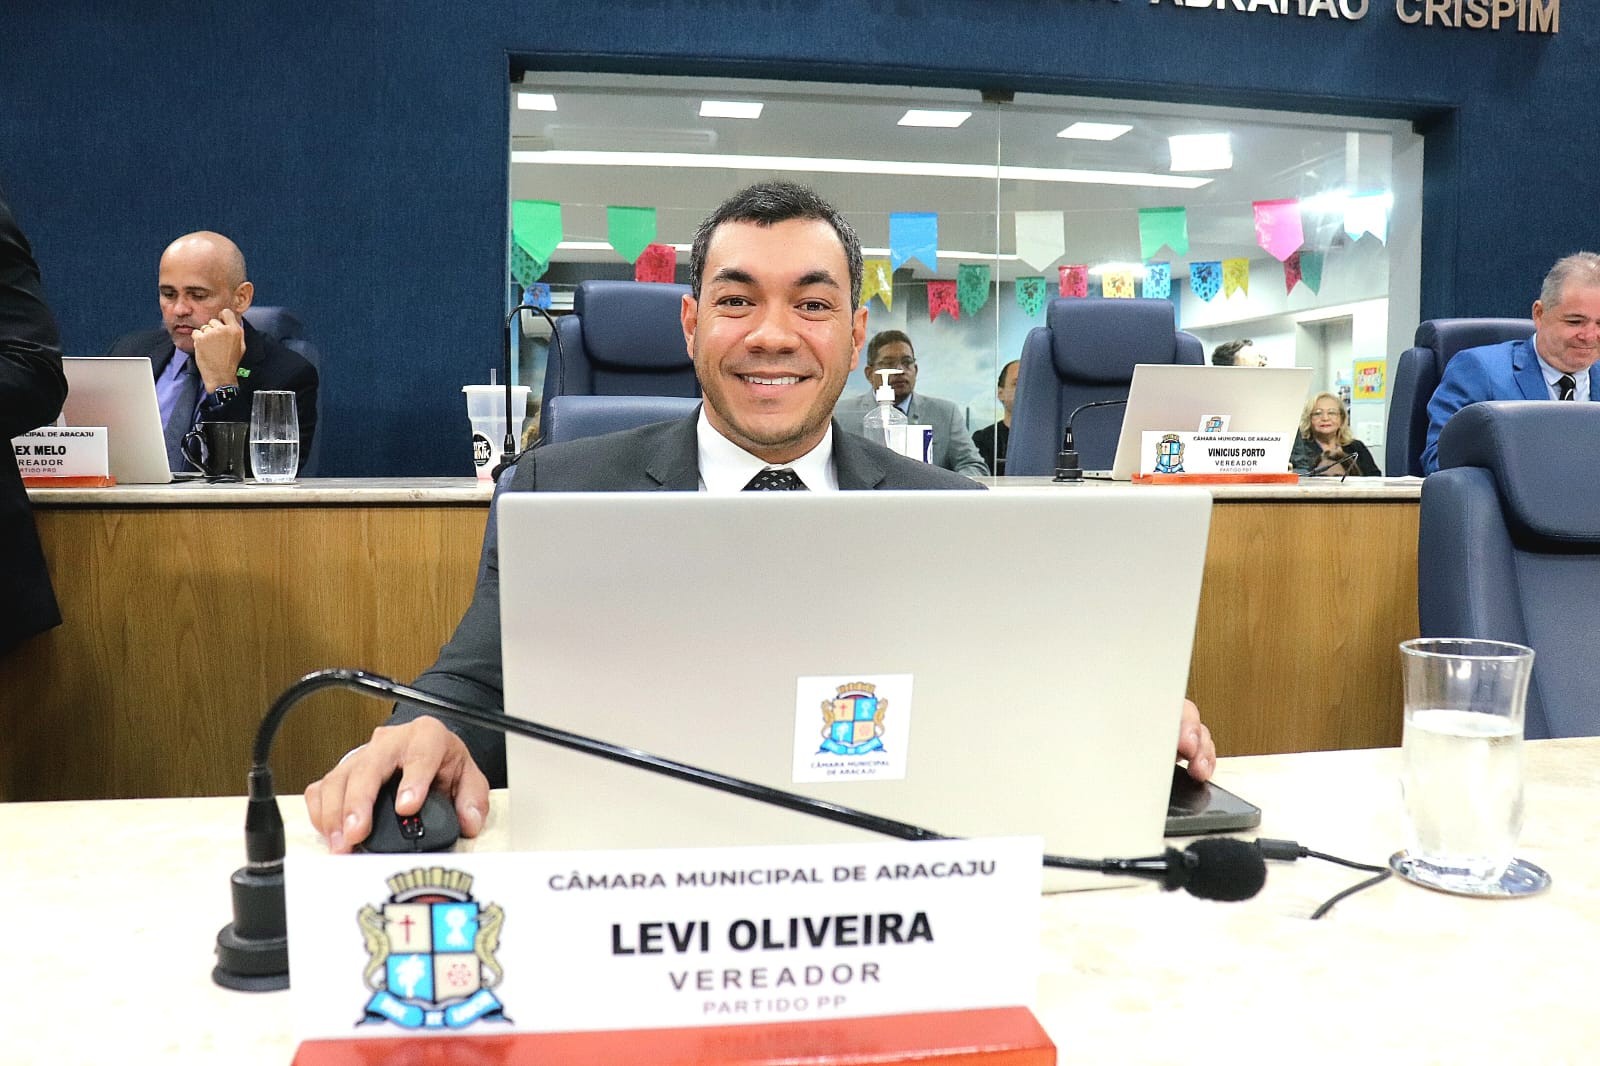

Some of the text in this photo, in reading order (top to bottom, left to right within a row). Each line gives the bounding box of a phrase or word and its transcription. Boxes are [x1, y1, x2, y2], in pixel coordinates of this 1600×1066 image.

[1396, 0, 1560, 33] CRISPIM
[15, 445, 67, 456] EX MELO
[1208, 447, 1266, 457] VINICIUS PORTO
[549, 860, 996, 891] CÂMARA MUNICIPAL DE ARACAJU
[611, 911, 934, 955] LEVI OLIVEIRA
[669, 962, 881, 992] VEREADOR
[703, 995, 847, 1015] PARTIDO PP
